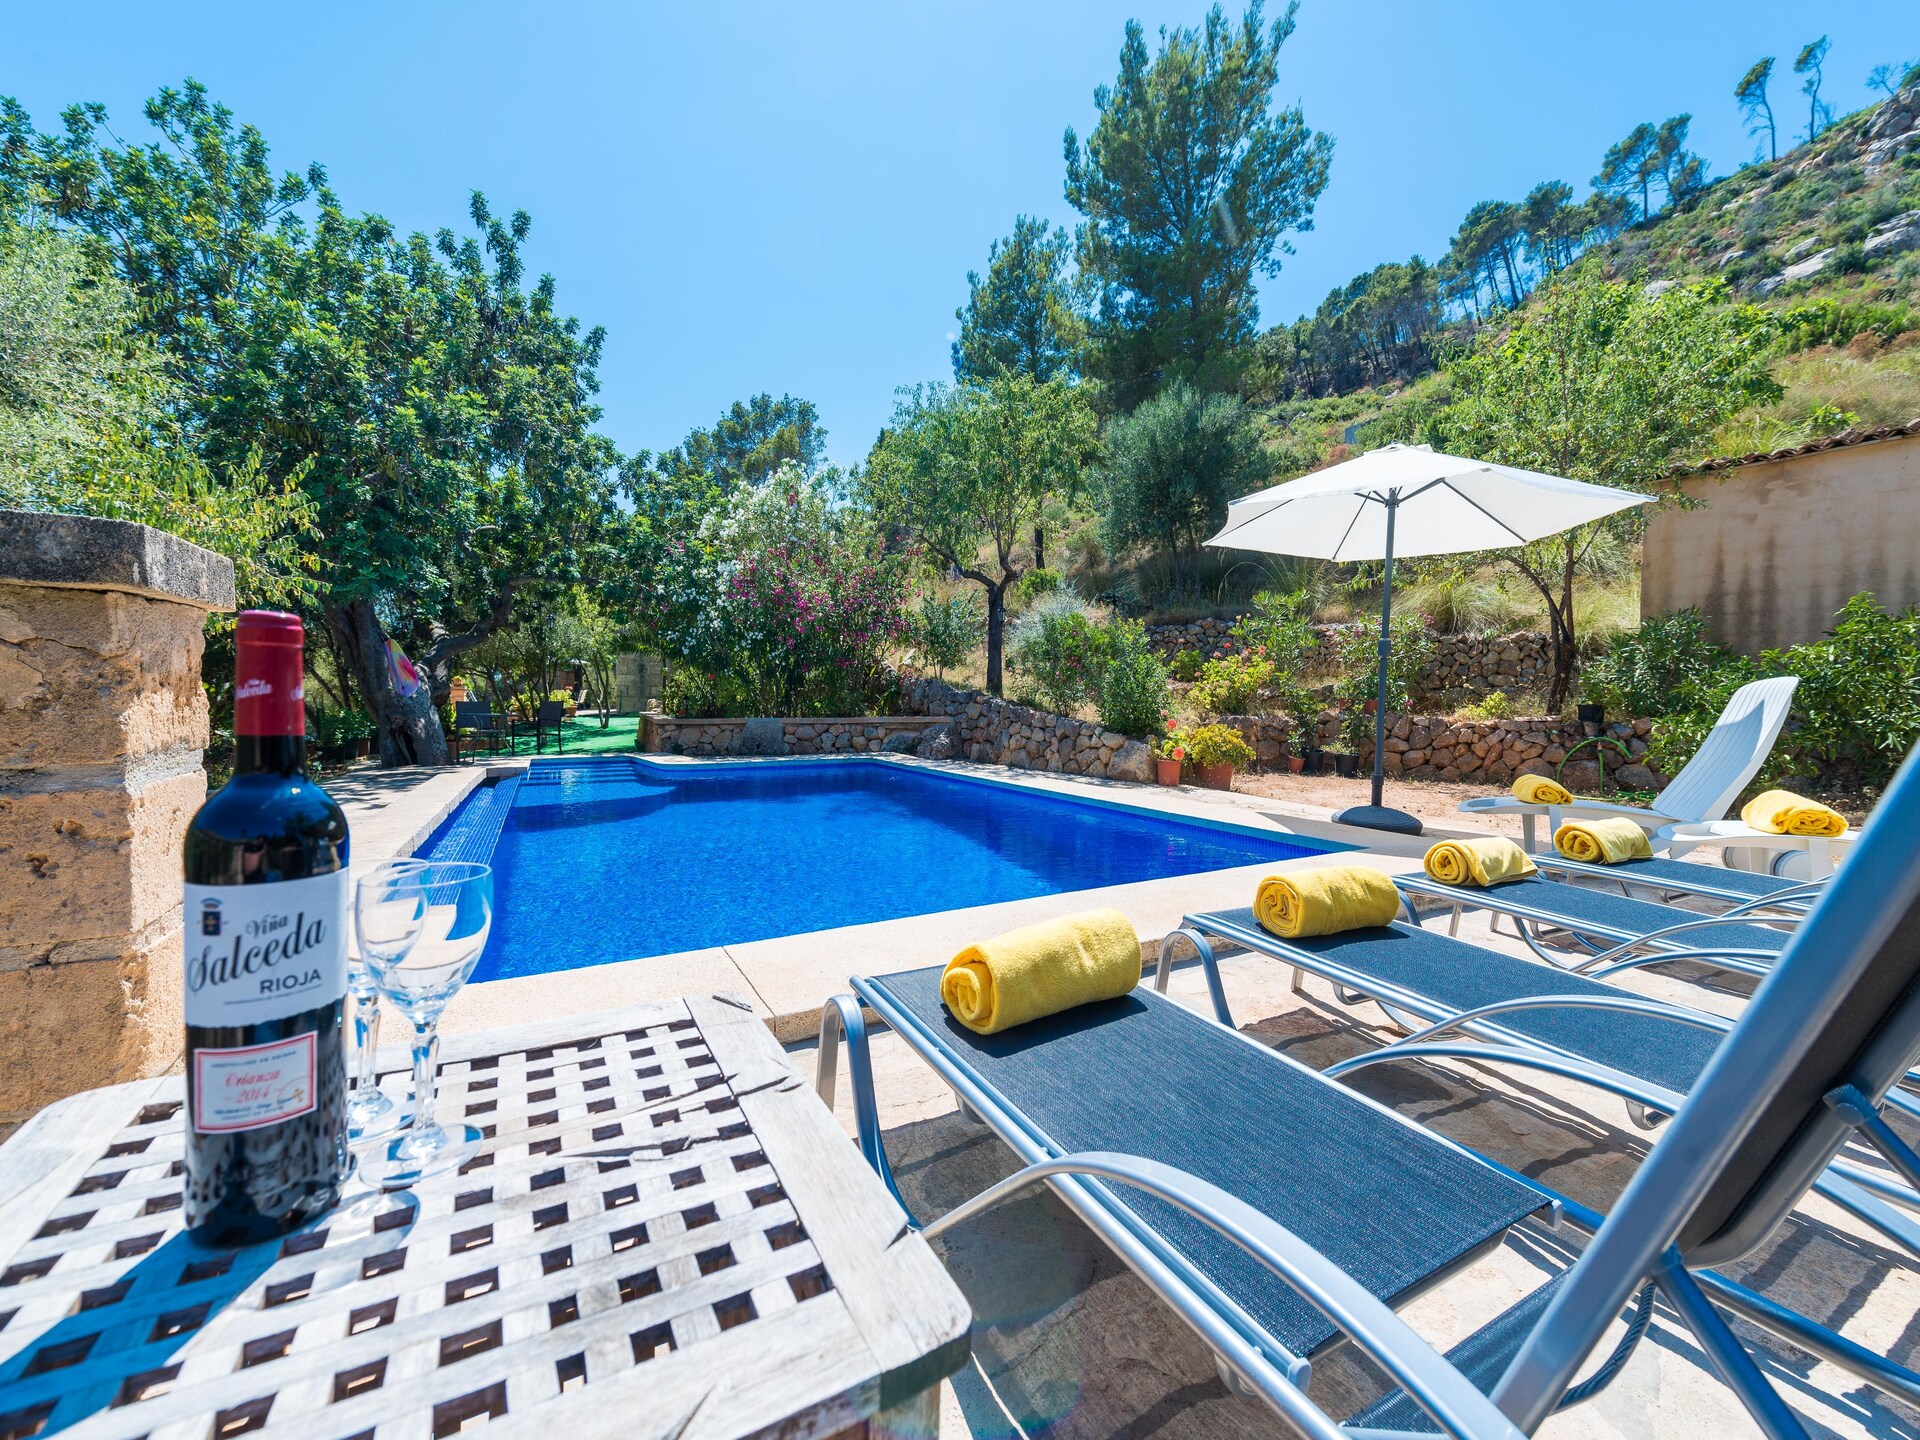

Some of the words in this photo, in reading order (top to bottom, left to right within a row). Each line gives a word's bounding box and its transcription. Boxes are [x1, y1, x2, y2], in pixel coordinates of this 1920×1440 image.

[246, 914, 288, 938] Viña
[187, 911, 326, 993] Salceda
[260, 969, 321, 994] RIOJA
